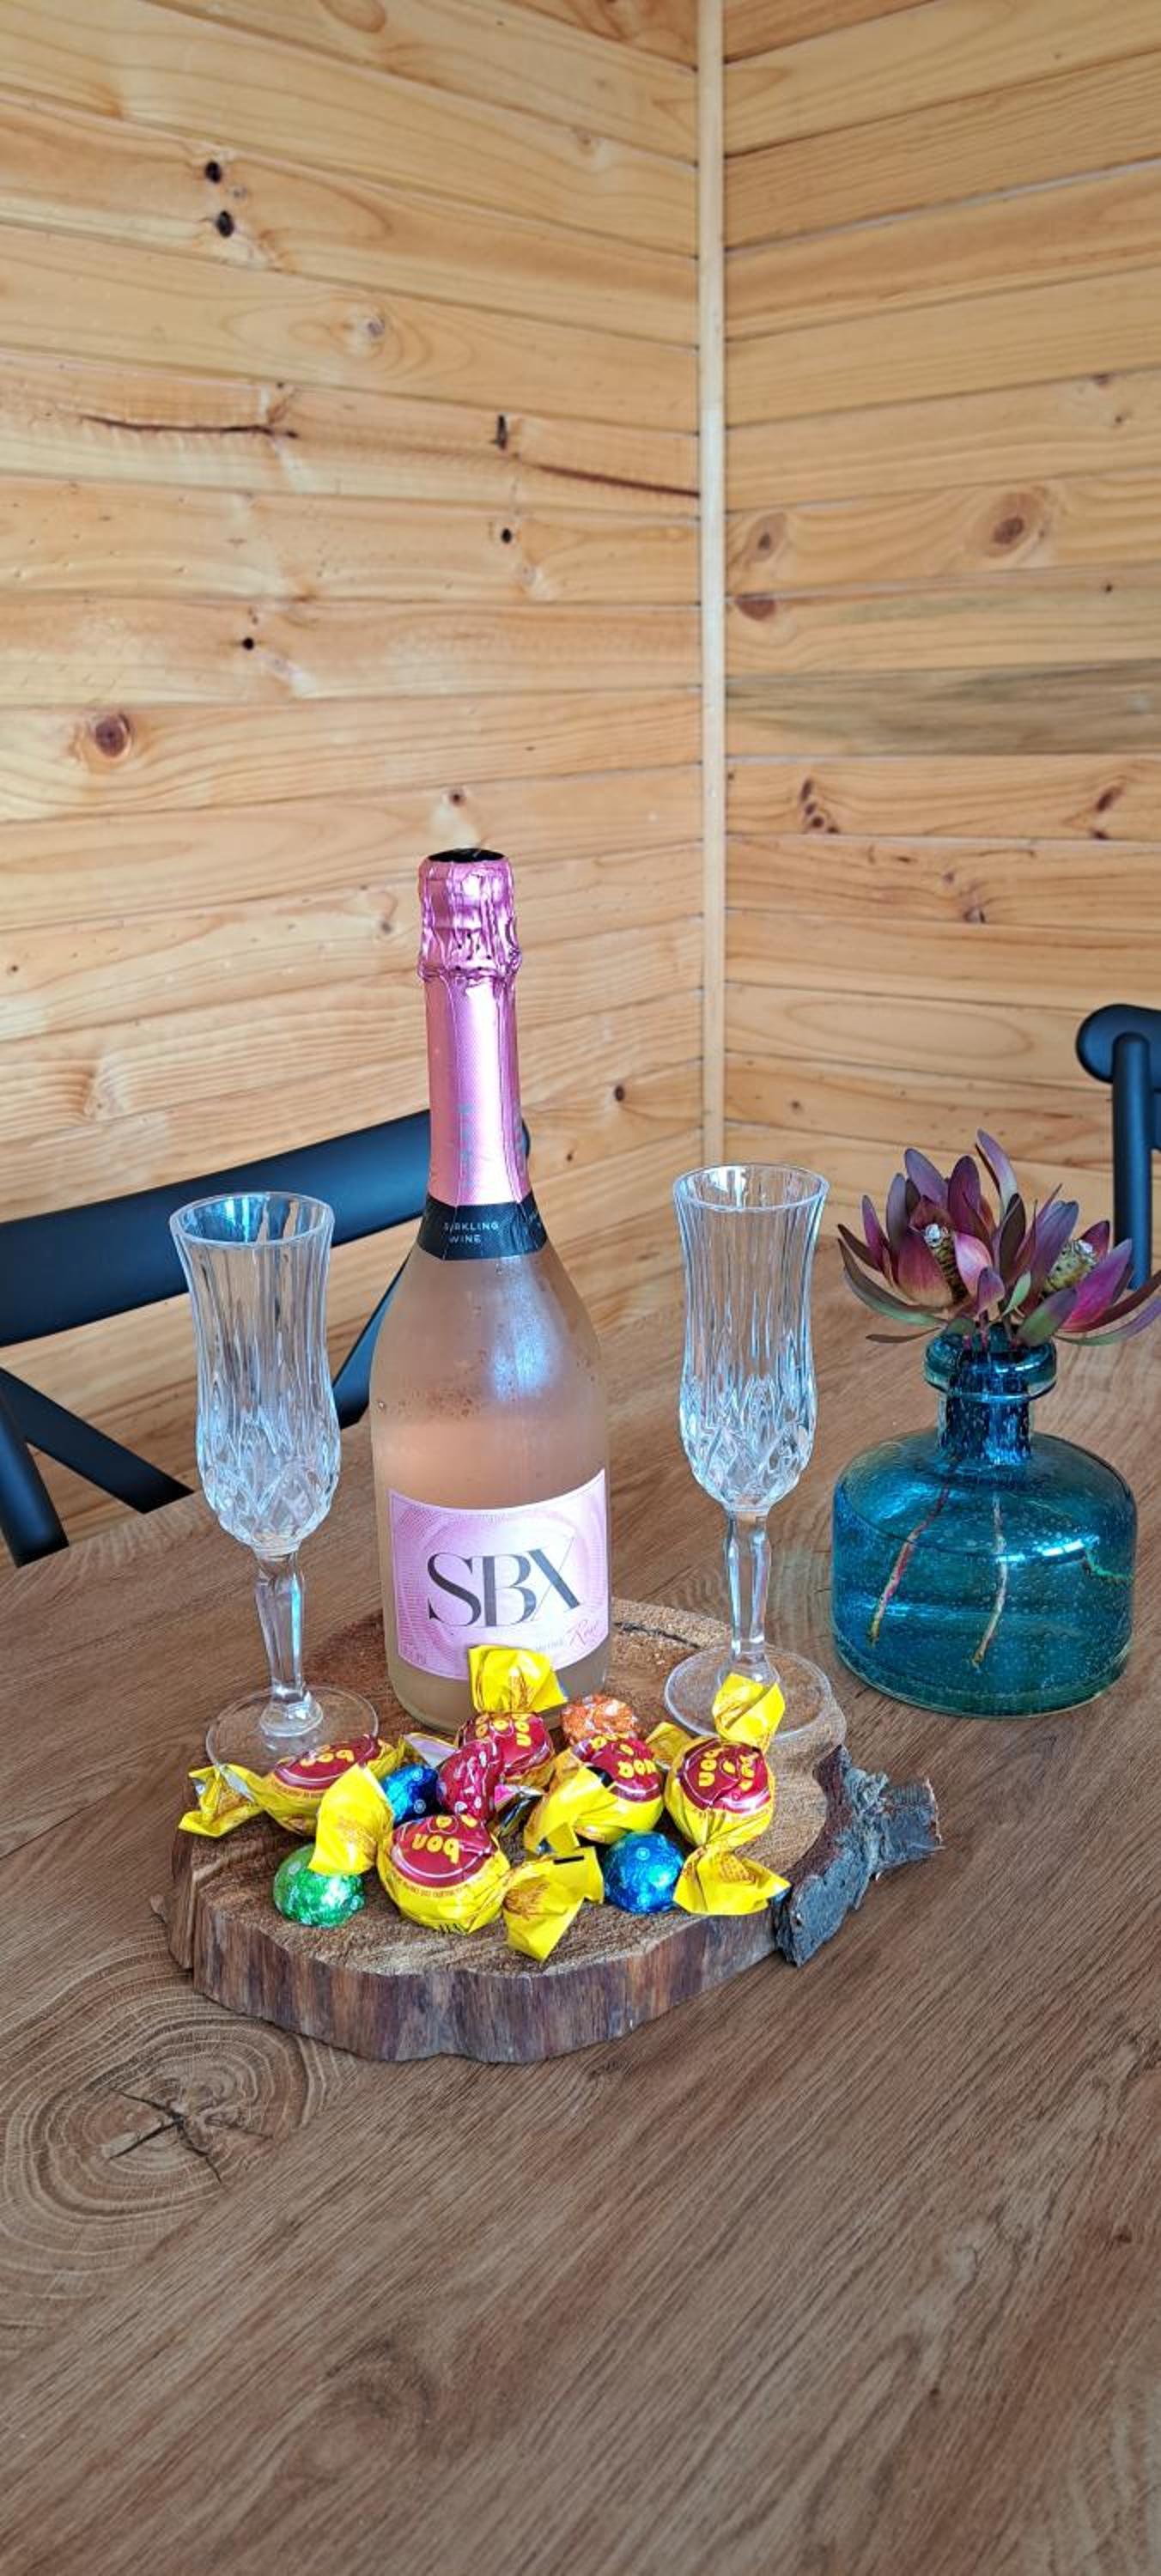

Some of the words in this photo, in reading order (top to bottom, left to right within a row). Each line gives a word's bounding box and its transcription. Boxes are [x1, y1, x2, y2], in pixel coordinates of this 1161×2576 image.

[448, 1234, 482, 1244] WINE
[427, 1538, 580, 1629] SBX
[410, 1832, 460, 1865] bon
